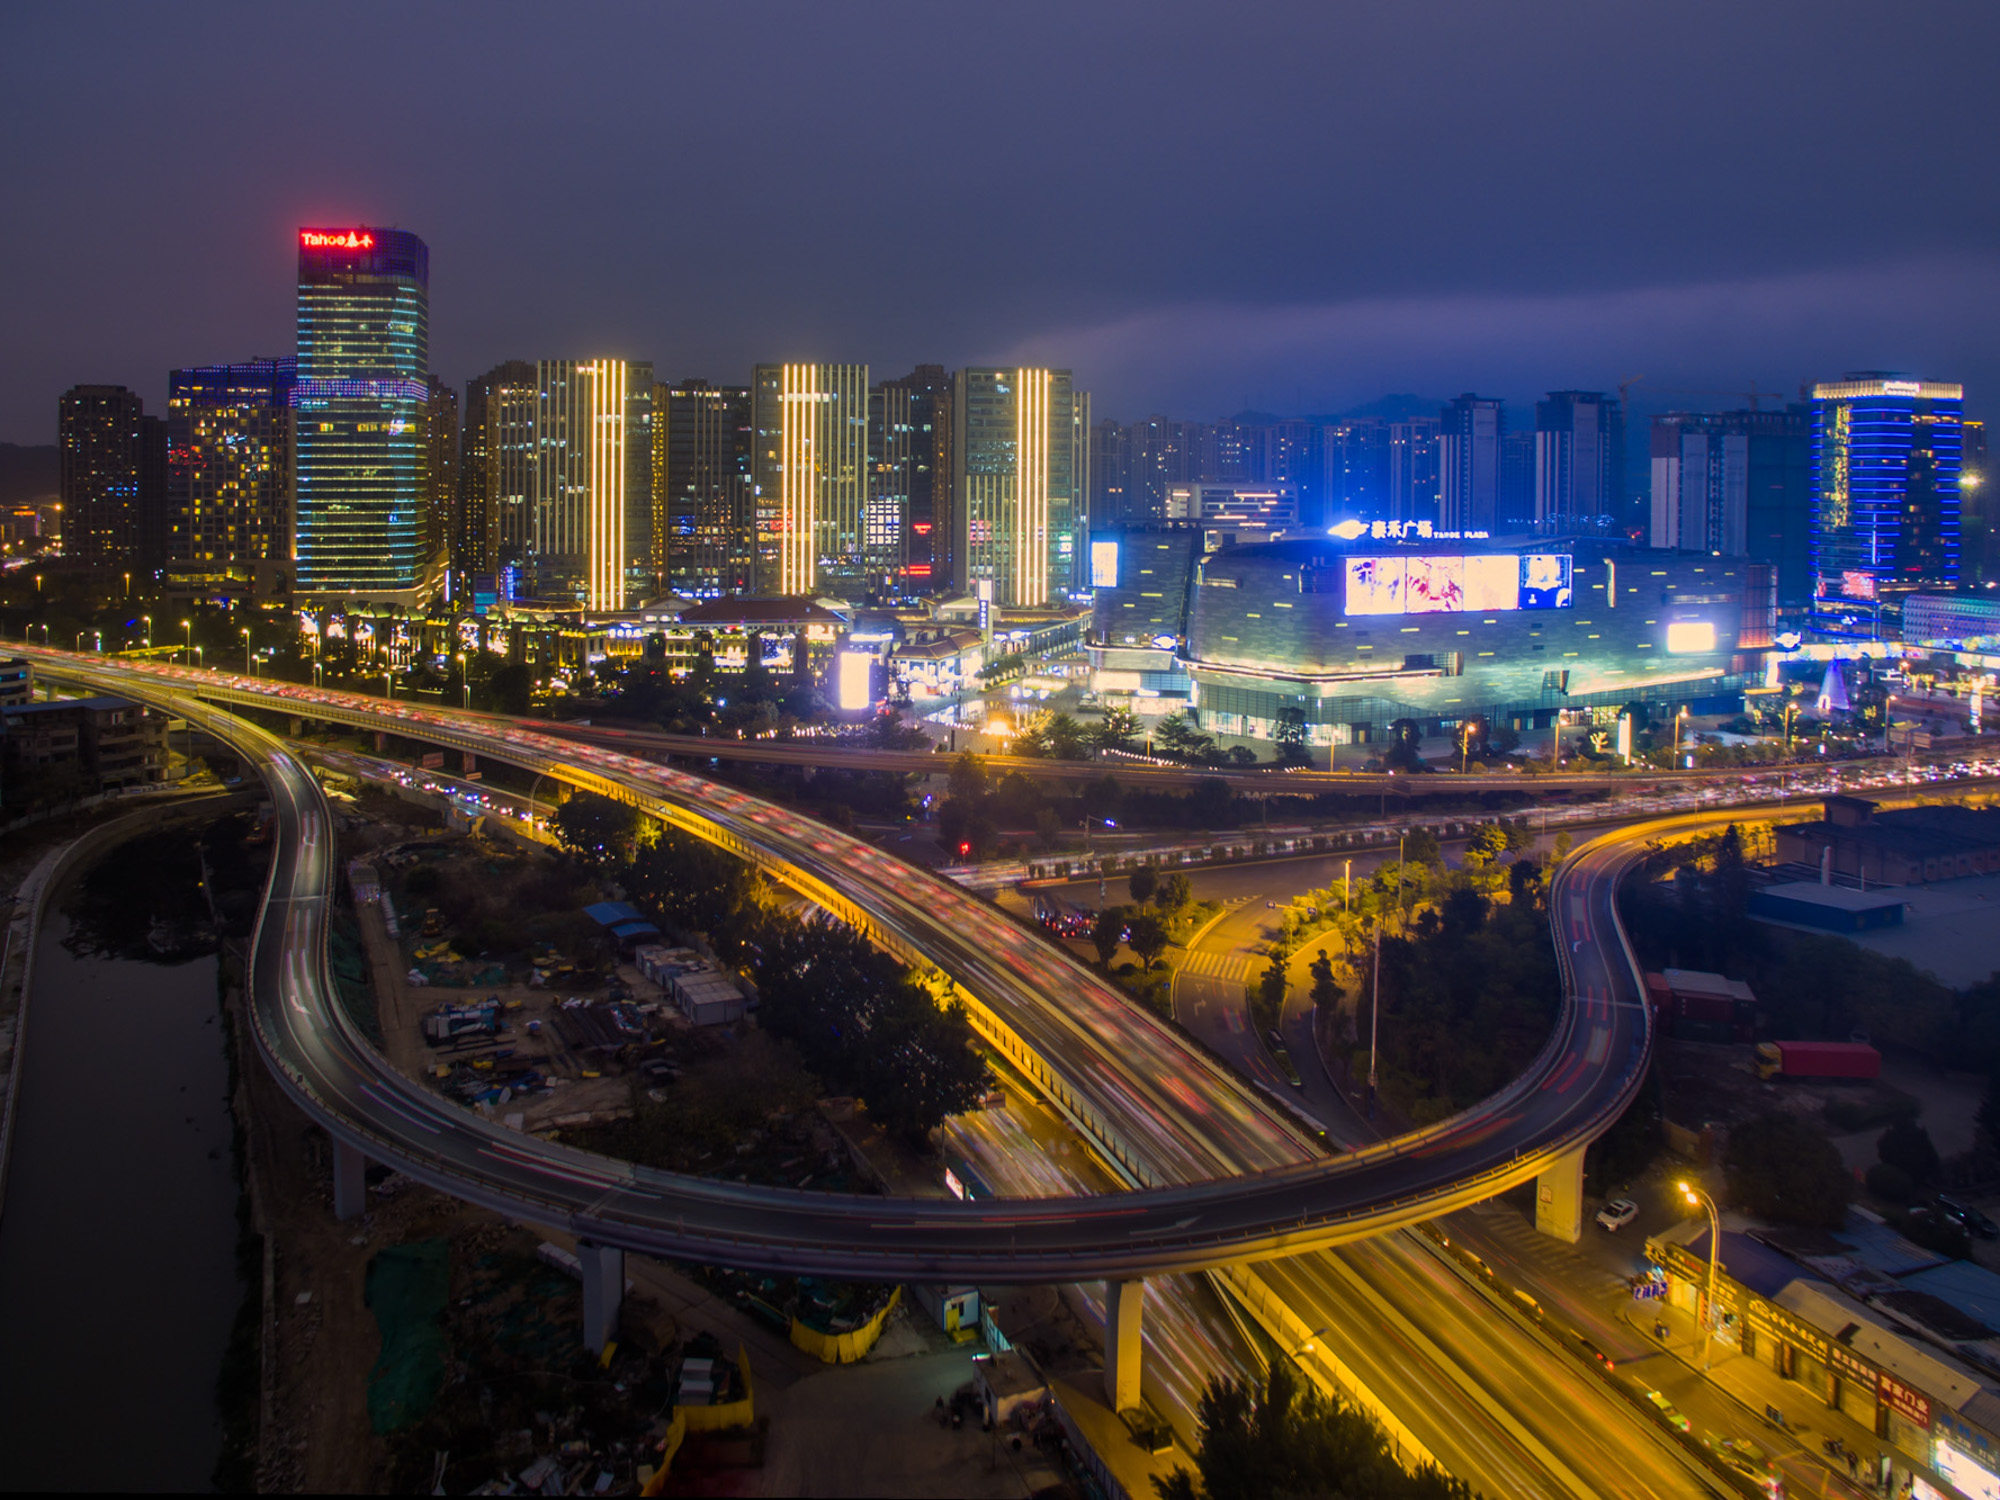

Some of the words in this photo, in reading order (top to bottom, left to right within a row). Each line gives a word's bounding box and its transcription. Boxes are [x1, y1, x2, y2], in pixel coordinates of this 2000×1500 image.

[301, 233, 345, 246] Tahoe
[1371, 520, 1433, 539] 泰禾广场
[1464, 531, 1489, 539] PLAZA
